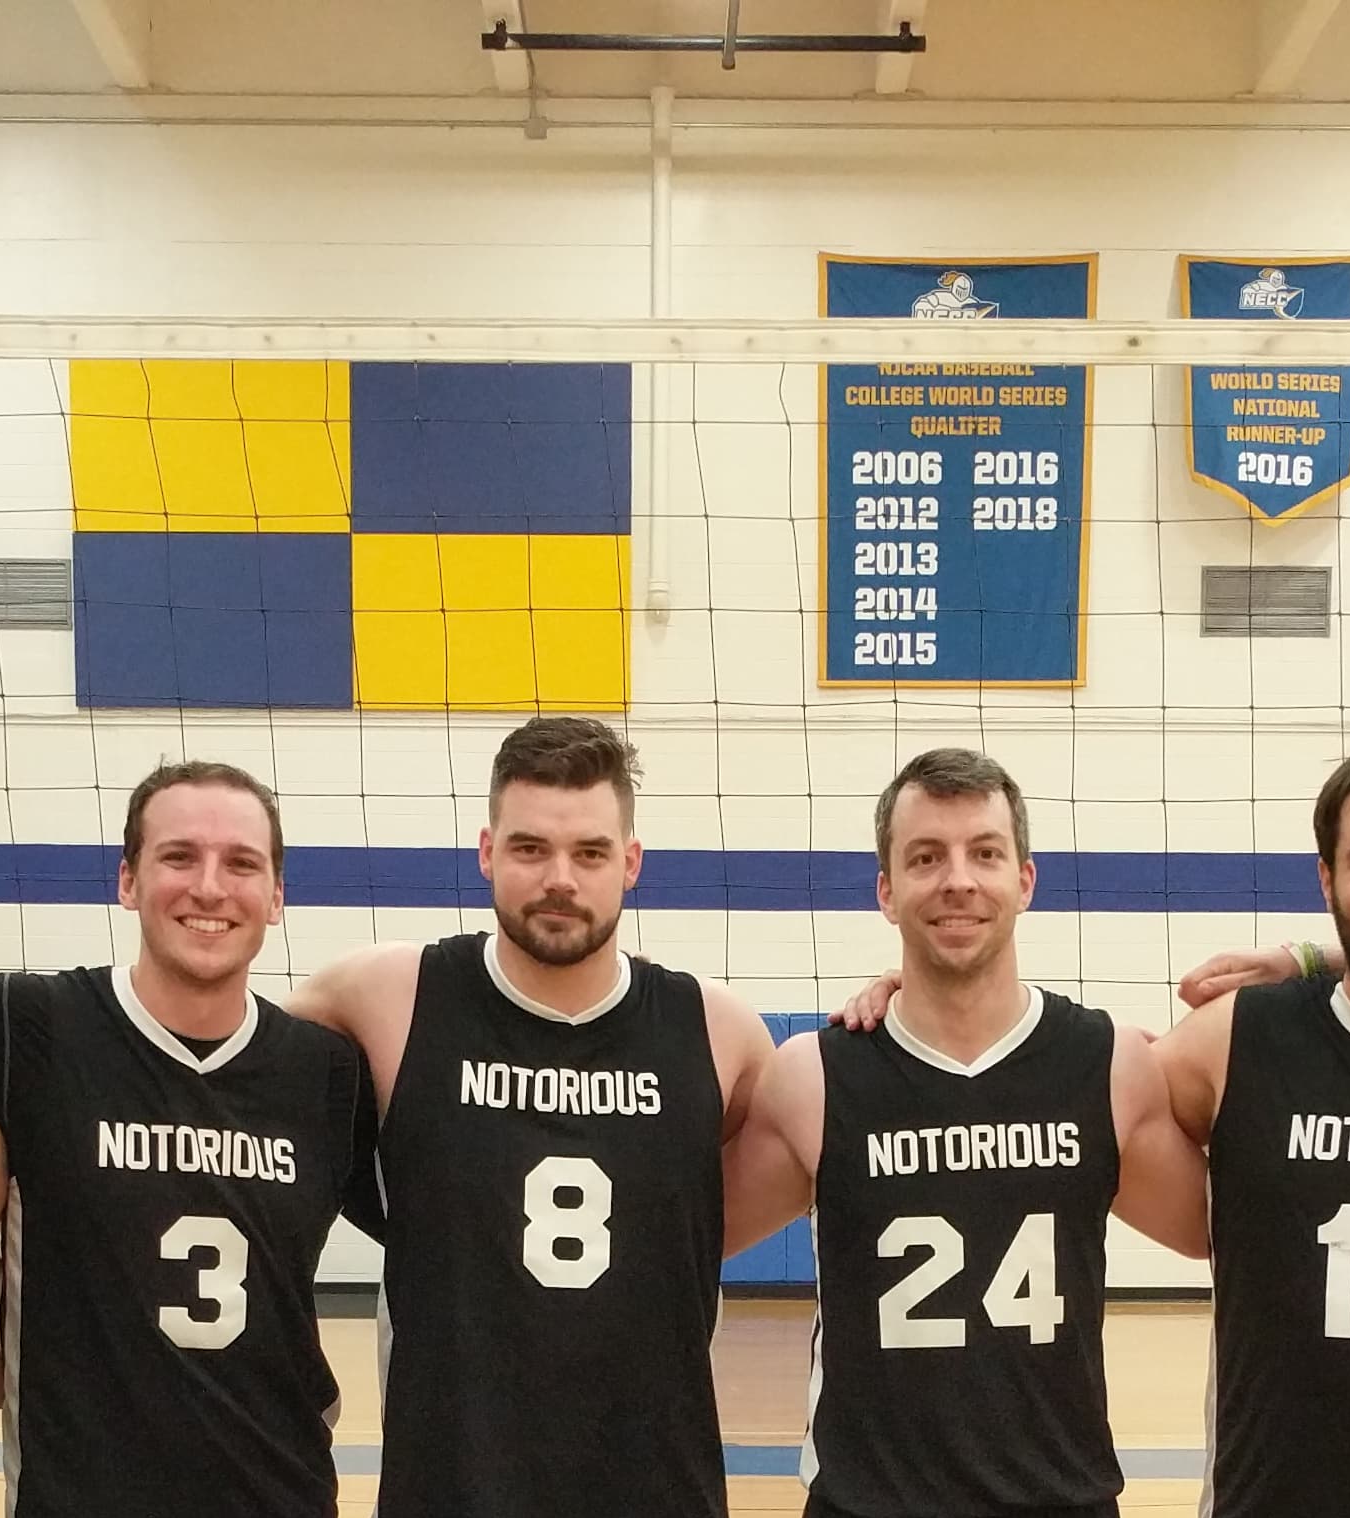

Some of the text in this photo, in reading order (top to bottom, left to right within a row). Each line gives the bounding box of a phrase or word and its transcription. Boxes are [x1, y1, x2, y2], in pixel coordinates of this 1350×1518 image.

[1243, 292, 1288, 306] NECC
[845, 386, 1068, 406] COLLEGE WORLD SERIES
[1210, 373, 1341, 393] WORLD SERIES
[1233, 398, 1320, 418] NATIONAL
[910, 415, 1002, 438] QUALIFER
[1226, 425, 1326, 445] RUNNER-UP
[853, 451, 1059, 485] 2006 2016
[1238, 451, 1314, 486] 2016
[855, 497, 1058, 530] 2012 2018
[854, 542, 939, 576] 2013
[854, 587, 938, 621] 2014
[854, 632, 937, 665] 2015
[460, 1059, 662, 1116] NOTORIOUS
[98, 1120, 297, 1184] NOTORIOUS
[867, 1121, 1081, 1178] NOTORIOUS
[522, 1156, 613, 1289] 8
[158, 1215, 249, 1350] 3
[877, 1212, 1065, 1349] 24
